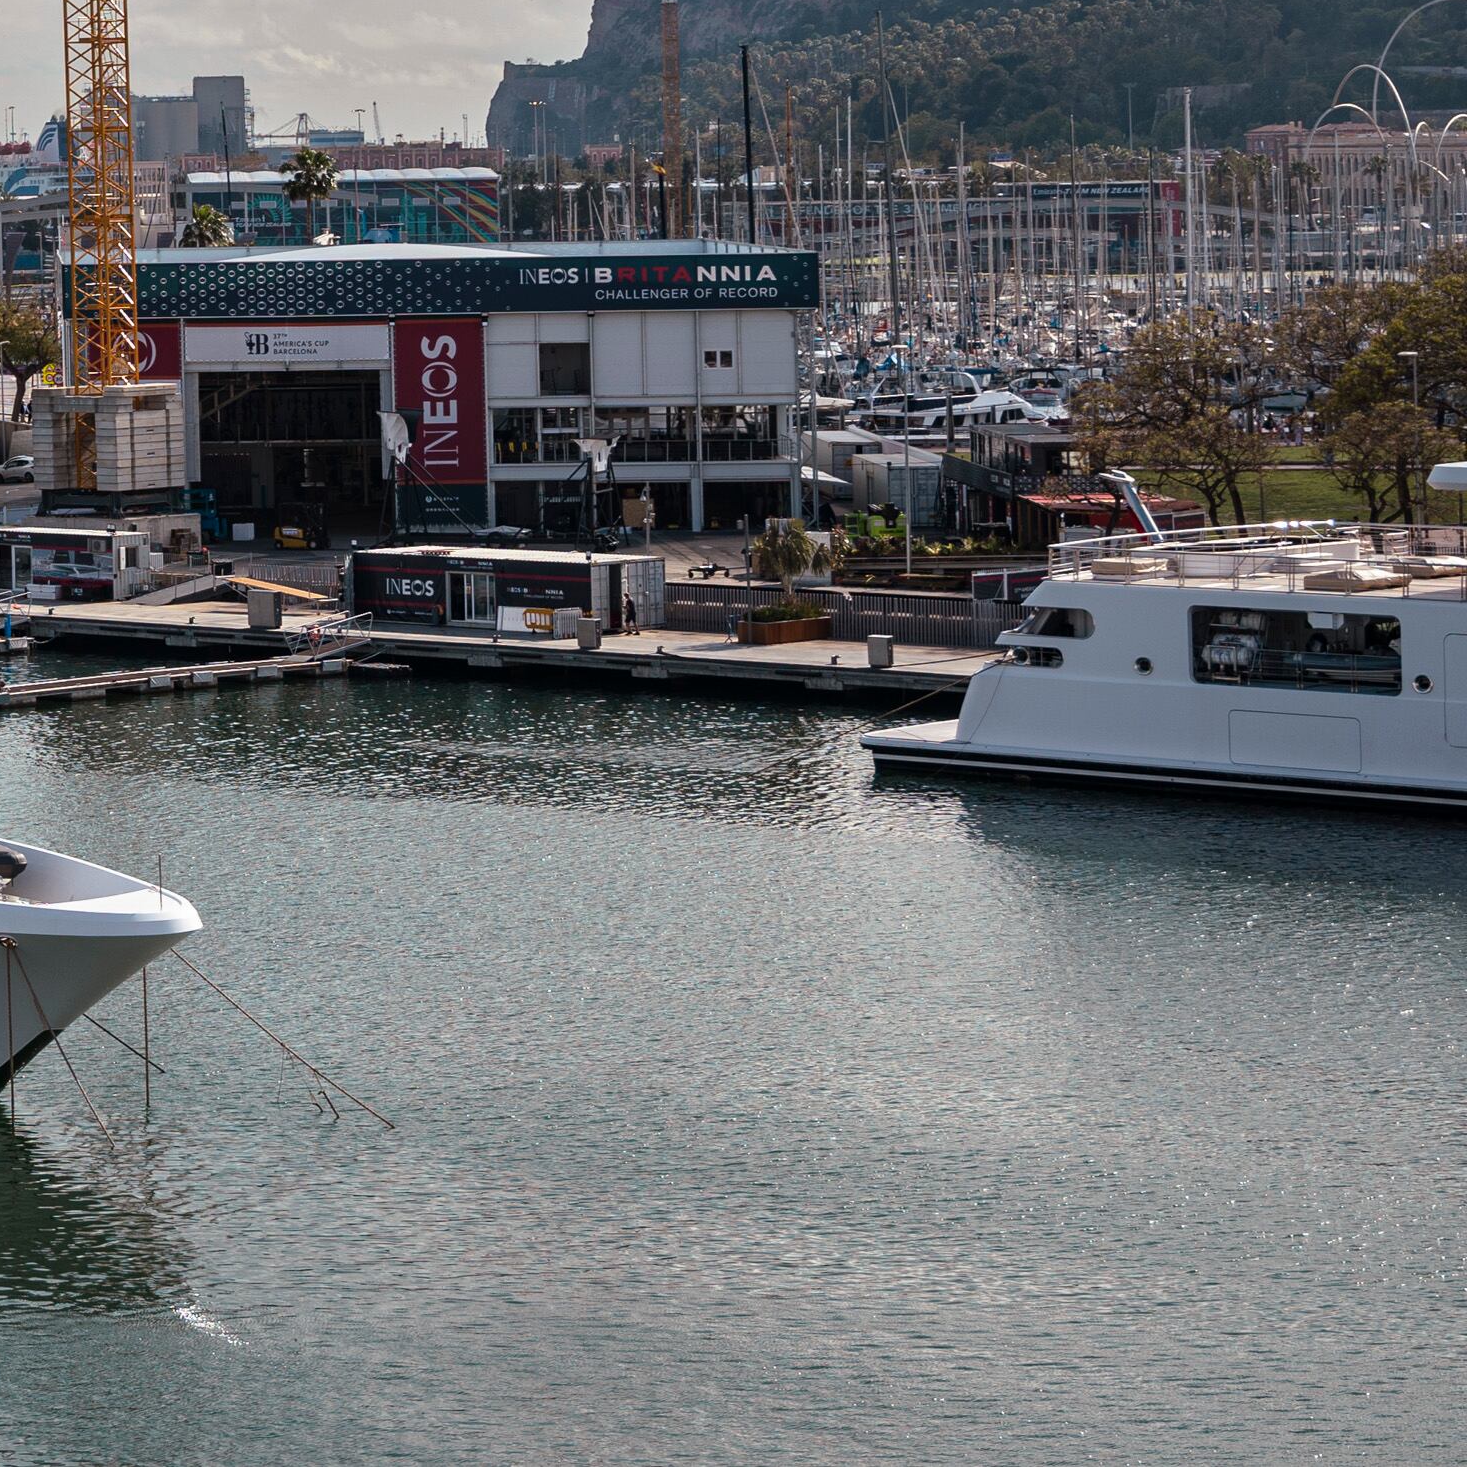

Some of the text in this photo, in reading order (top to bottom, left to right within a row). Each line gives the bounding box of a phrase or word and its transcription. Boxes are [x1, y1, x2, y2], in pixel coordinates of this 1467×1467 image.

[519, 265, 777, 285] INEOS BRITANNIA
[595, 287, 778, 300] CHALLENGER OF RECORD
[420, 334, 459, 468] INEOS
[386, 577, 435, 597] INEOS
